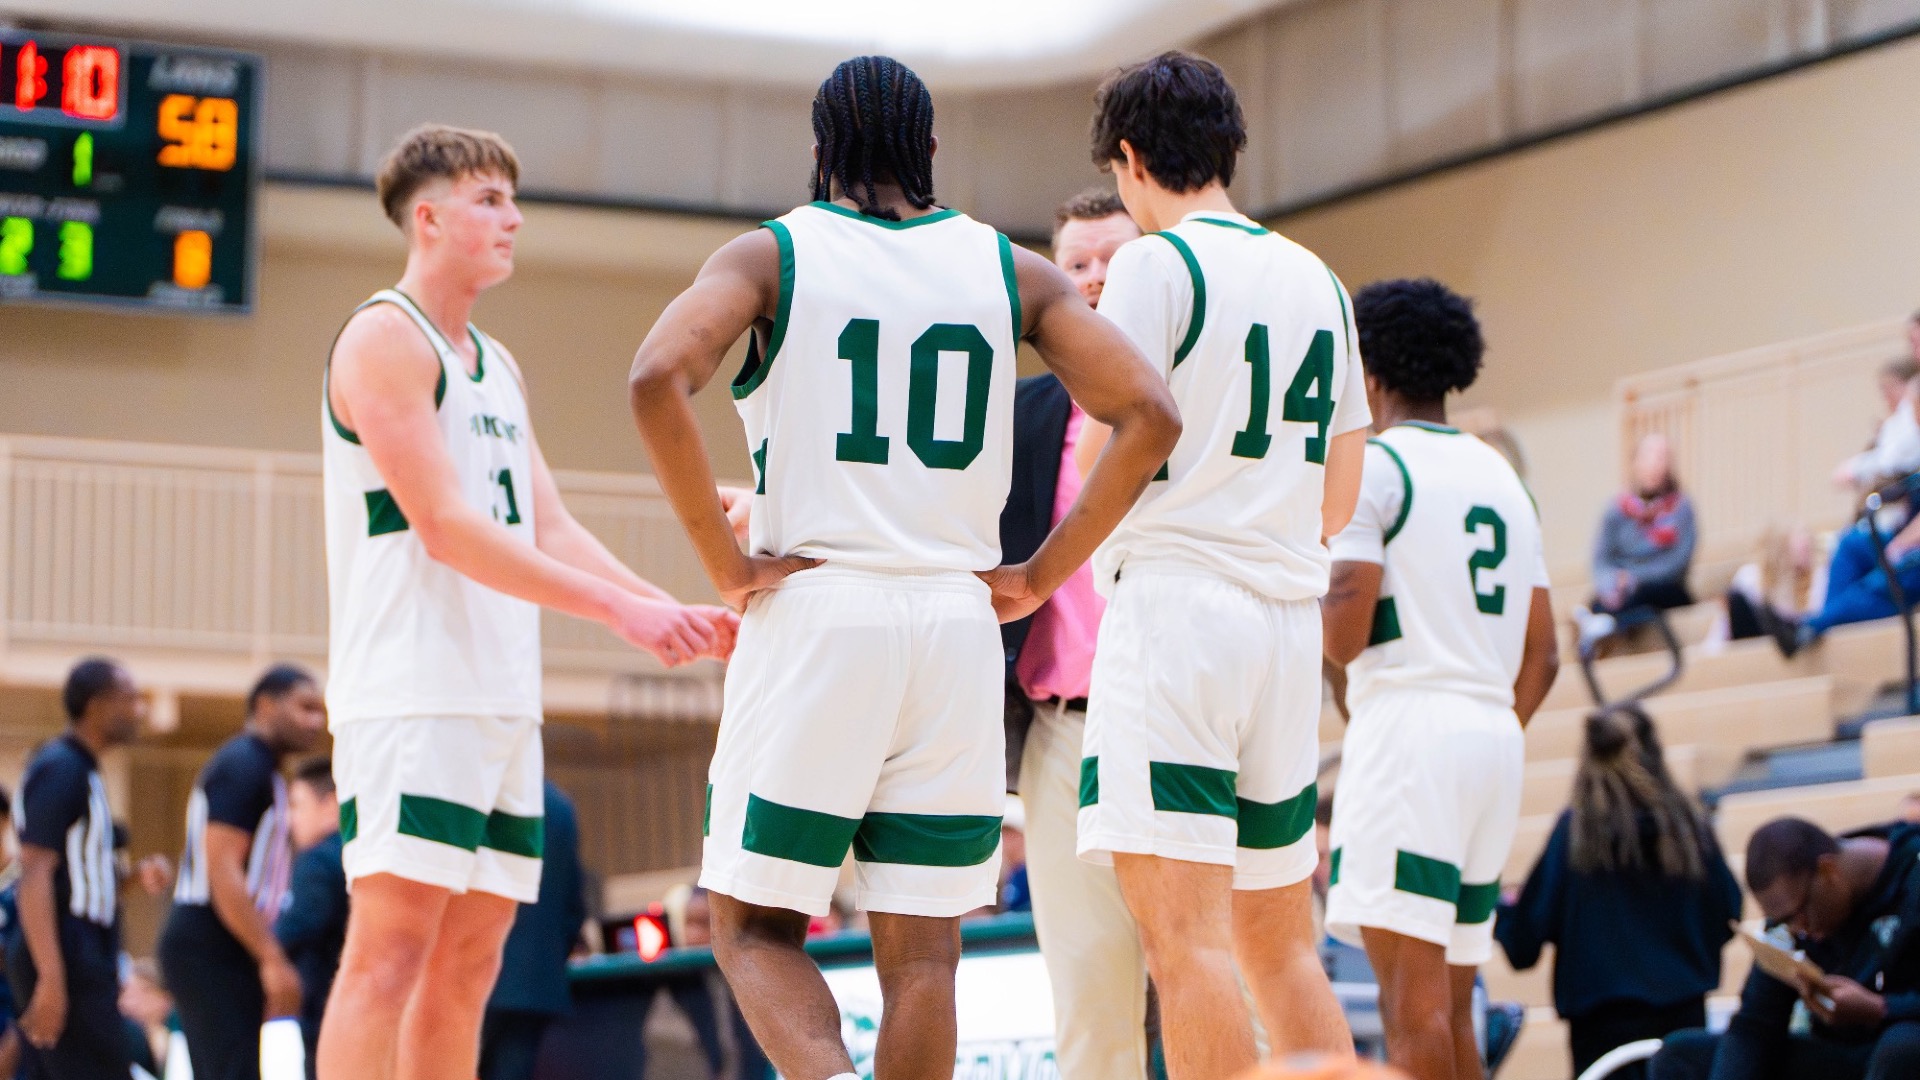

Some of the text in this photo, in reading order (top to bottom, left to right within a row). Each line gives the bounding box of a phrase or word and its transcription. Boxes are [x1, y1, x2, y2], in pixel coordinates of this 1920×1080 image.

[0, 40, 119, 121] 1:10
[72, 130, 93, 187] 1
[158, 94, 238, 170] 58
[836, 318, 994, 470] 10
[1231, 323, 1336, 465] 14
[489, 468, 521, 524] 1
[1464, 505, 1507, 615] 2
